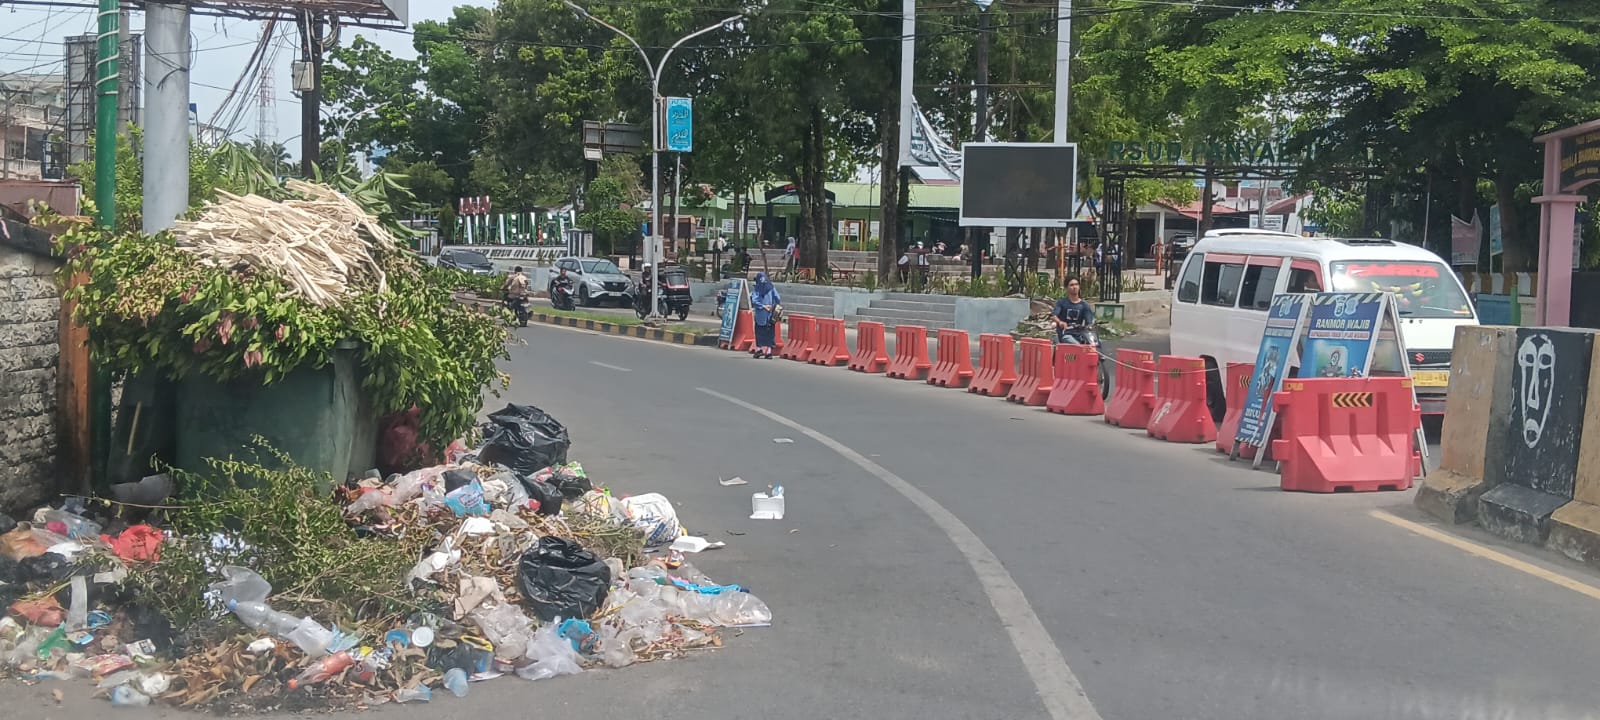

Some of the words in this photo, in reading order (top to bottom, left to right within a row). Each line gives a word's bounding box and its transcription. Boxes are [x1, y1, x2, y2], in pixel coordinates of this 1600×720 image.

[1108, 141, 1182, 162] RSUD
[1315, 319, 1345, 329] RANMOR
[1347, 319, 1371, 330] WAJIB
